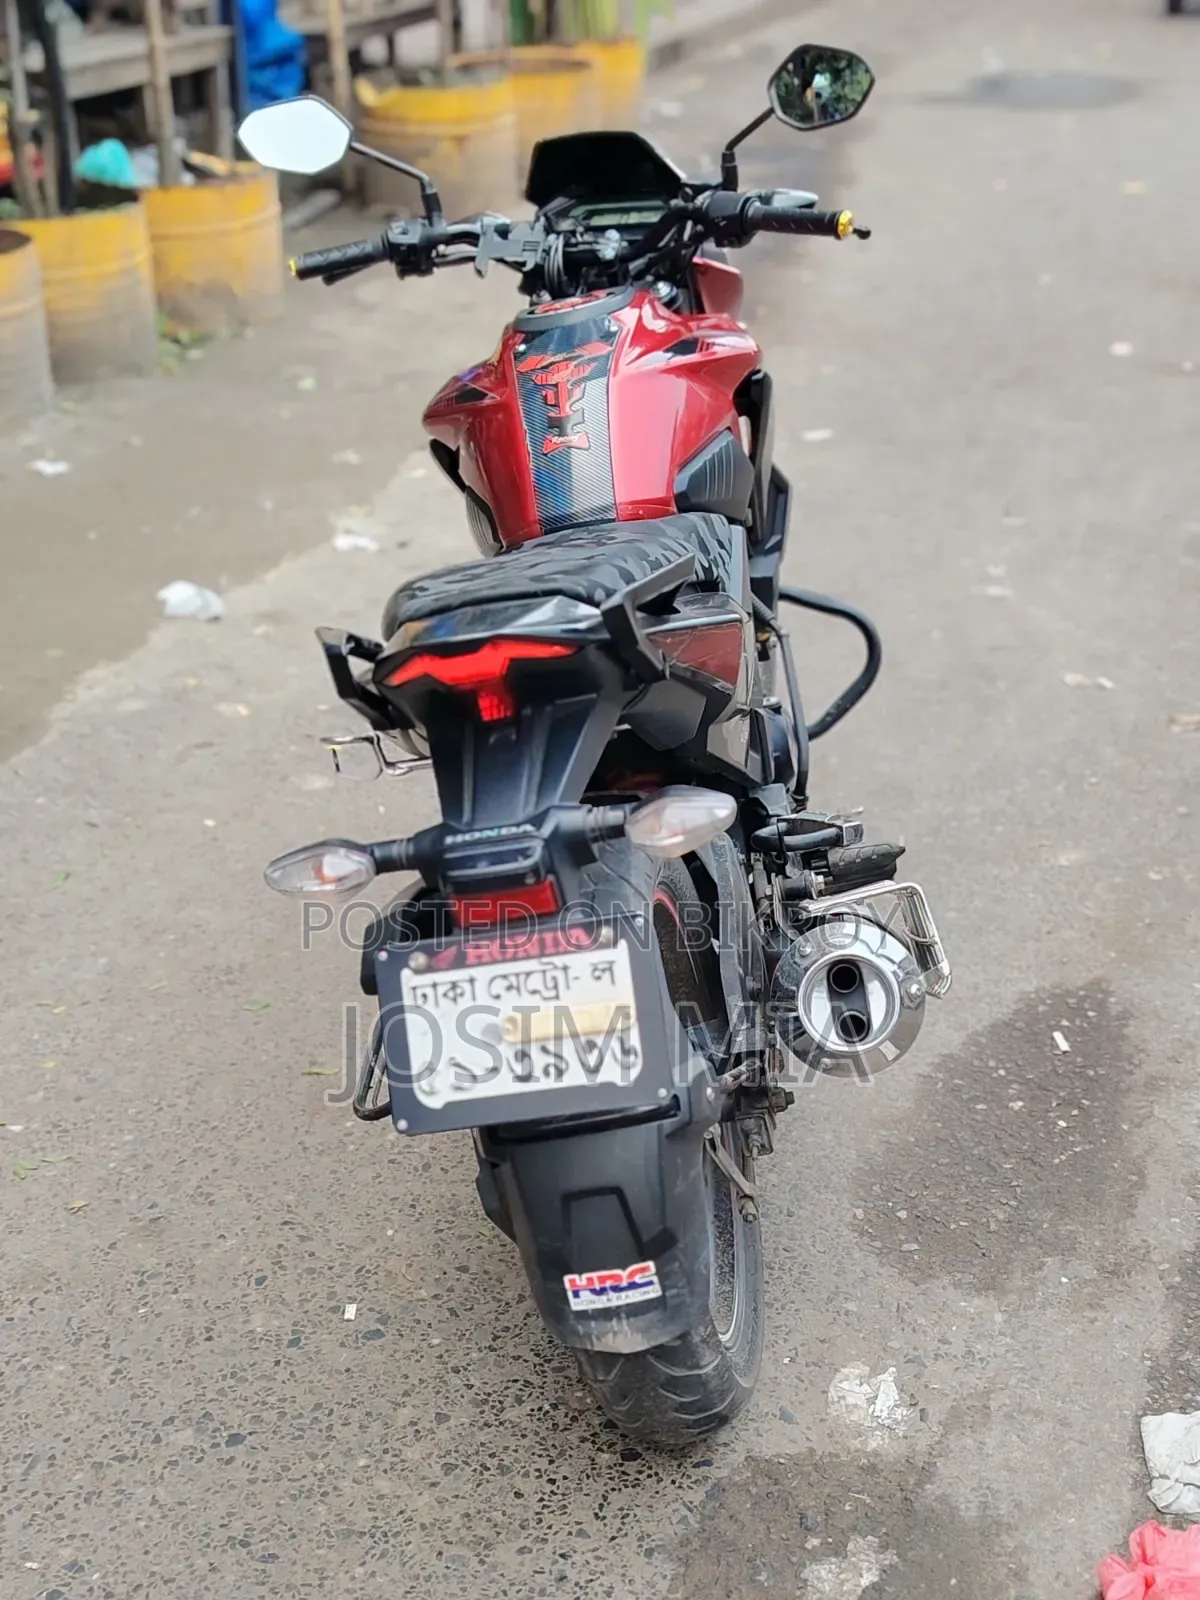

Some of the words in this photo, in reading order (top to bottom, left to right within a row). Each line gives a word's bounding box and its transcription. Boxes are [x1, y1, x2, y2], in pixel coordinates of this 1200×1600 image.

[445, 824, 536, 845] HONDA
[410, 973, 477, 1009] ঢাকা
[565, 1262, 656, 1299] HRC
